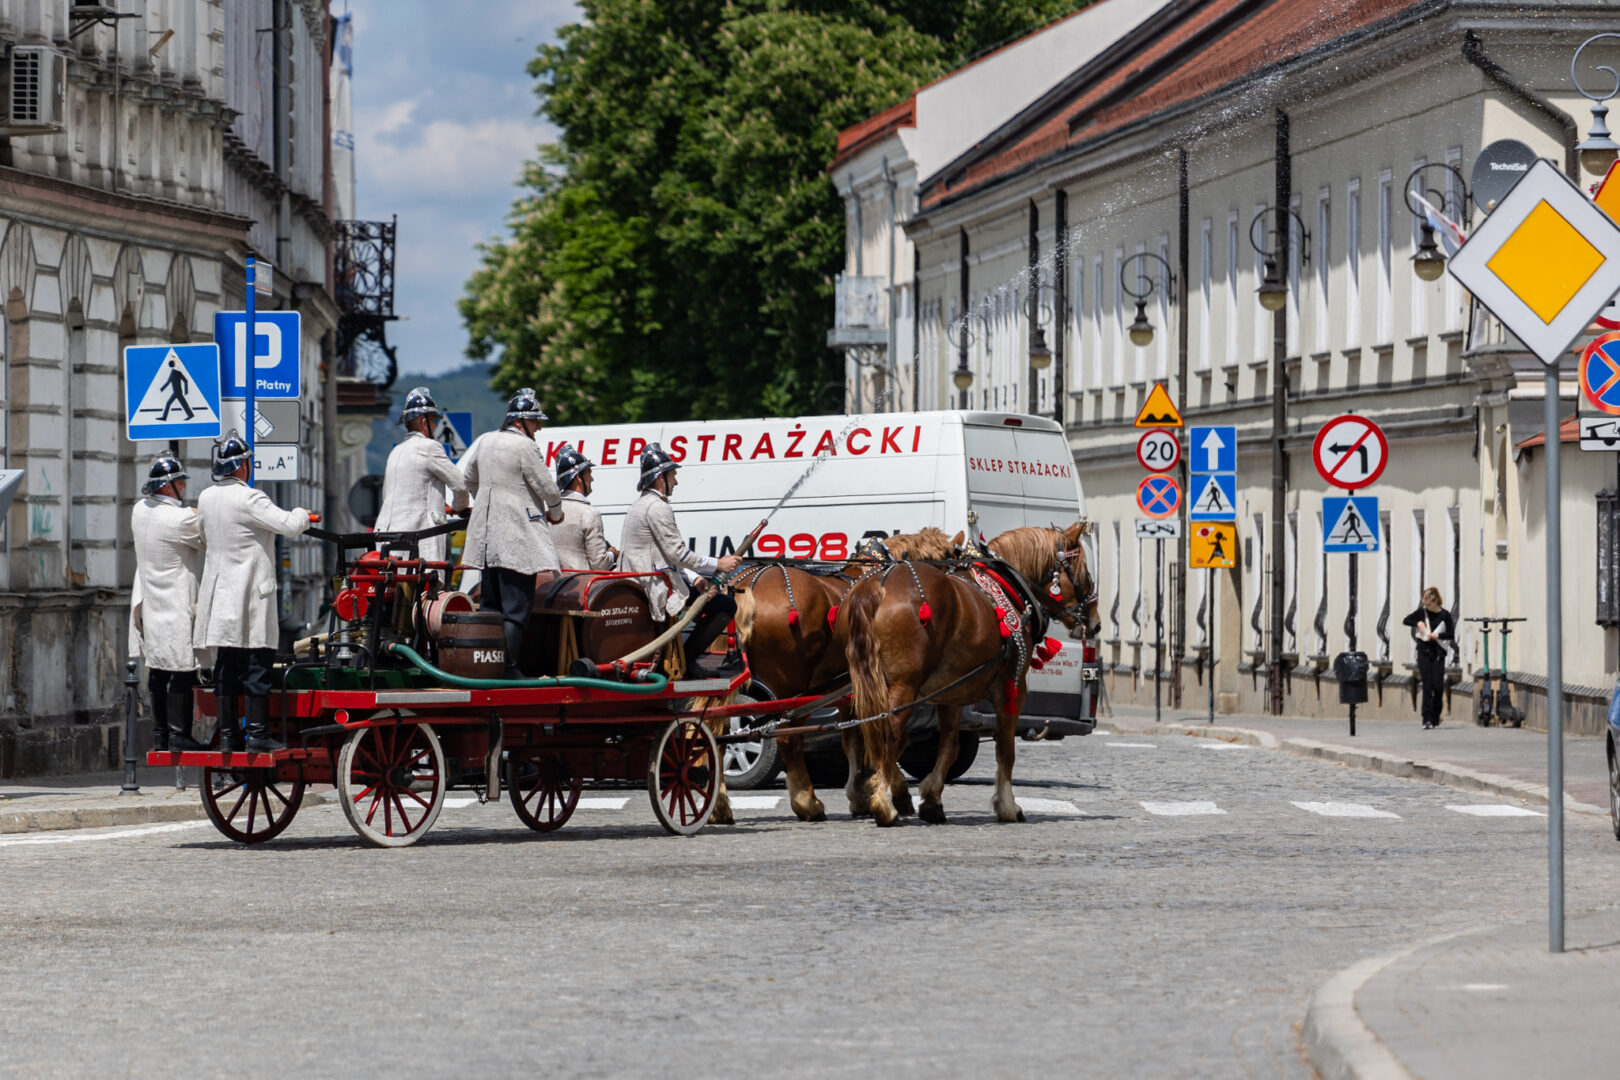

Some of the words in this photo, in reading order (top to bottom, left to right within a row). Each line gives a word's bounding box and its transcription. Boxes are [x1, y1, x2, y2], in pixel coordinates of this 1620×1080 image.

[255, 379, 291, 393] Płatny
[669, 423, 922, 463] STRAŻACKI
[1145, 440, 1175, 462] 20
[969, 457, 1003, 472] SKLEP
[1007, 459, 1071, 478] STRAŻACKI
[473, 650, 504, 663] PiASE
